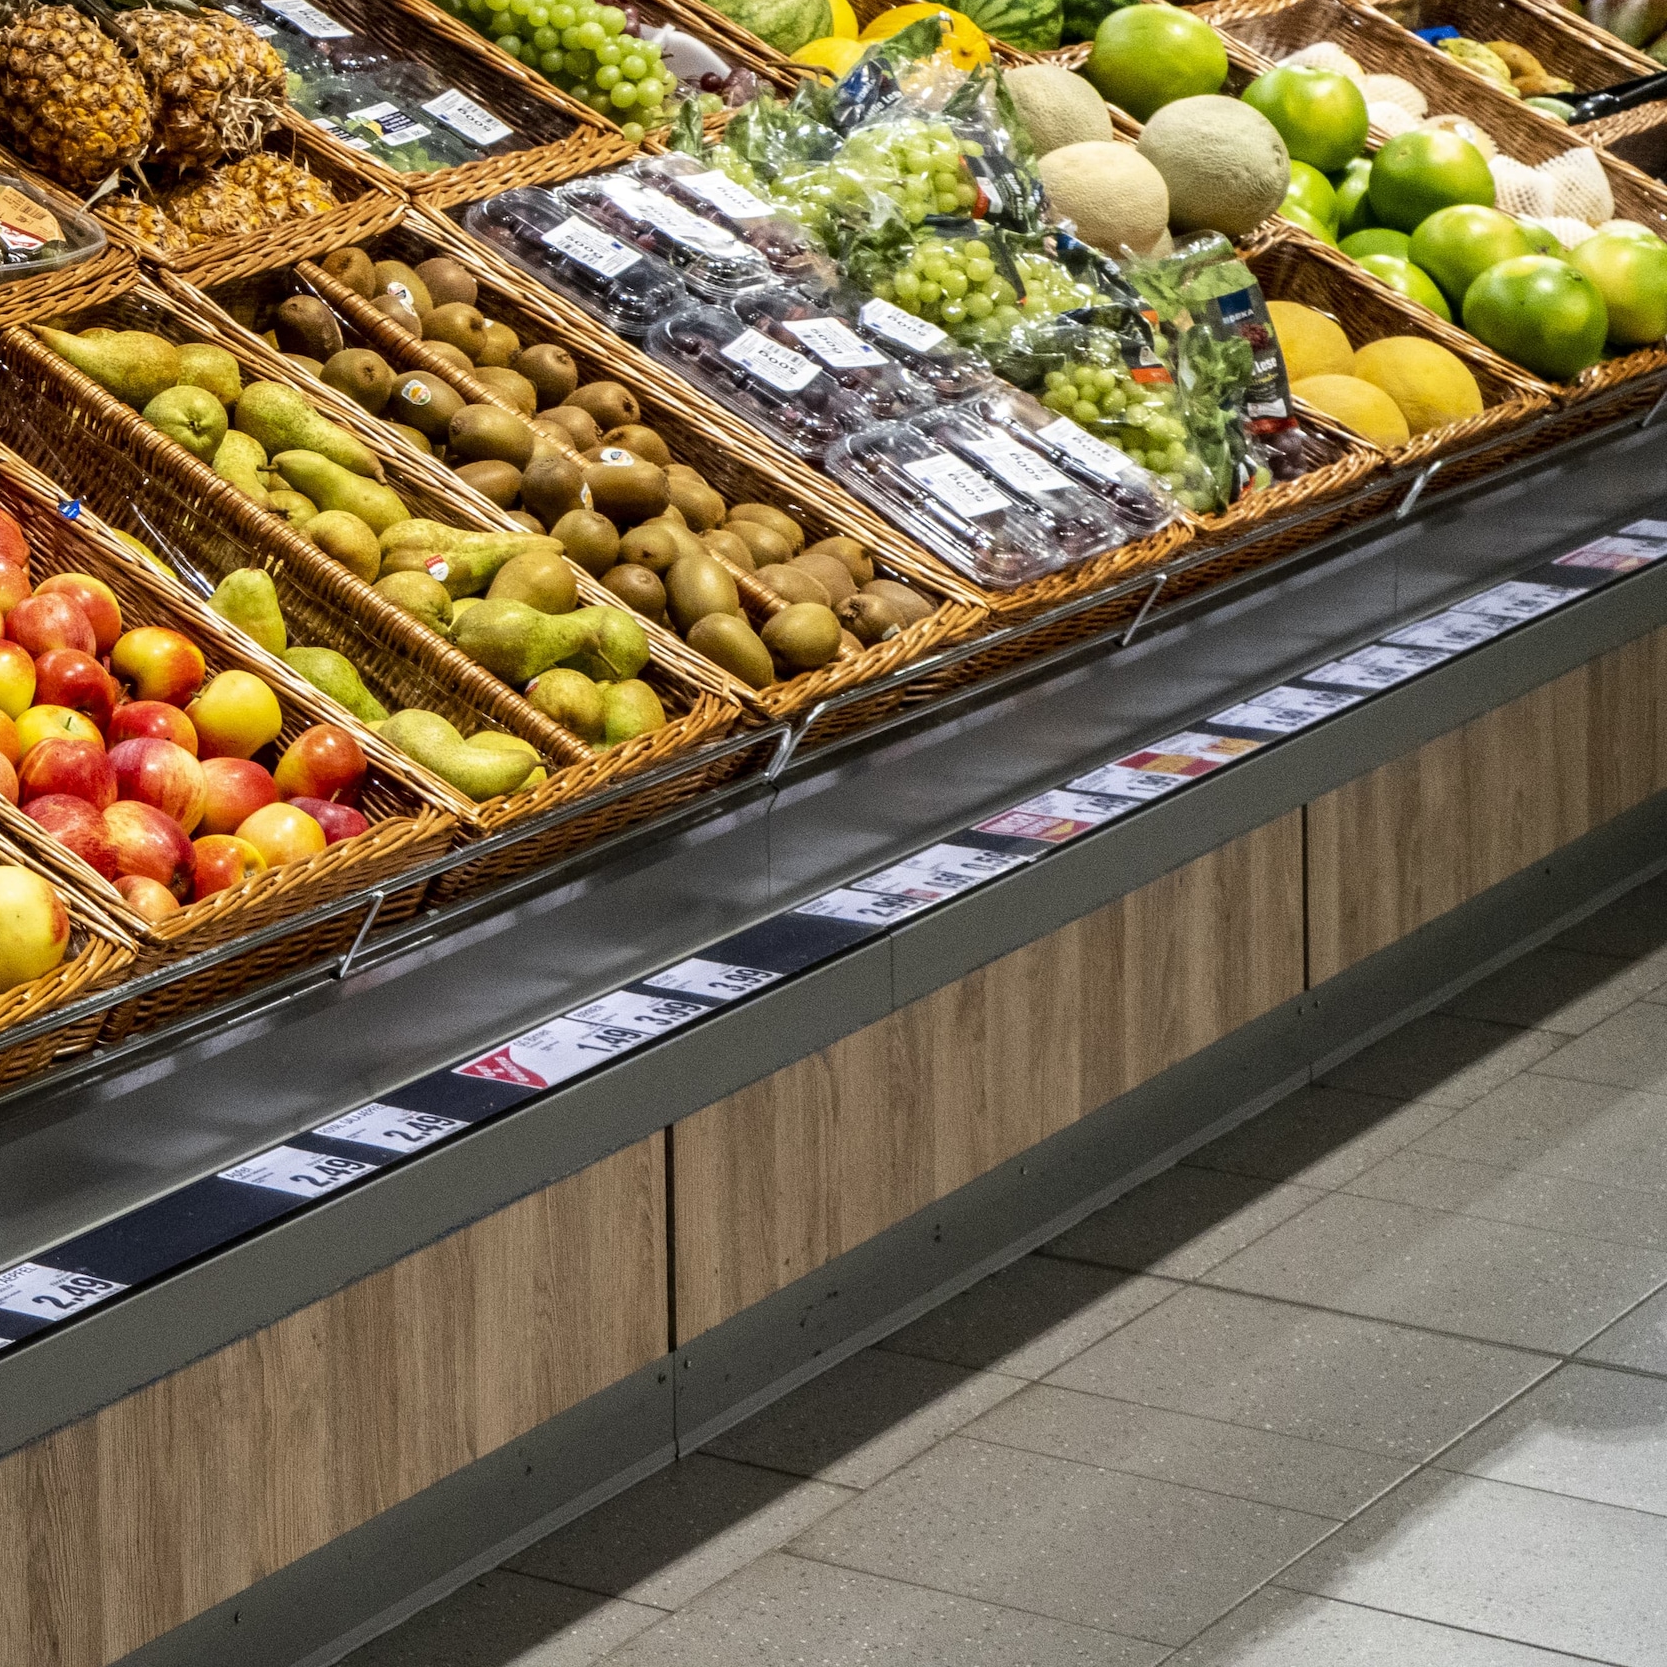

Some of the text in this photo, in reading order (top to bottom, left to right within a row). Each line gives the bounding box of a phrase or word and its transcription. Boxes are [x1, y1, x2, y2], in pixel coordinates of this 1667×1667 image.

[566, 234, 603, 260] 500g
[886, 313, 927, 338] 500g
[1221, 308, 1255, 325] EDEKA
[810, 326, 844, 355] 500g
[757, 349, 799, 377] 500g
[1008, 451, 1044, 482] 500g
[946, 471, 984, 504] 500g
[856, 894, 920, 919] 2.99
[708, 968, 774, 993] 3.99
[634, 1001, 703, 1026] 3.99
[576, 1028, 643, 1054] 1.49
[383, 1115, 456, 1143] 2.49
[289, 1158, 366, 1188] 2.49
[31, 1277, 114, 1310] 2.49
